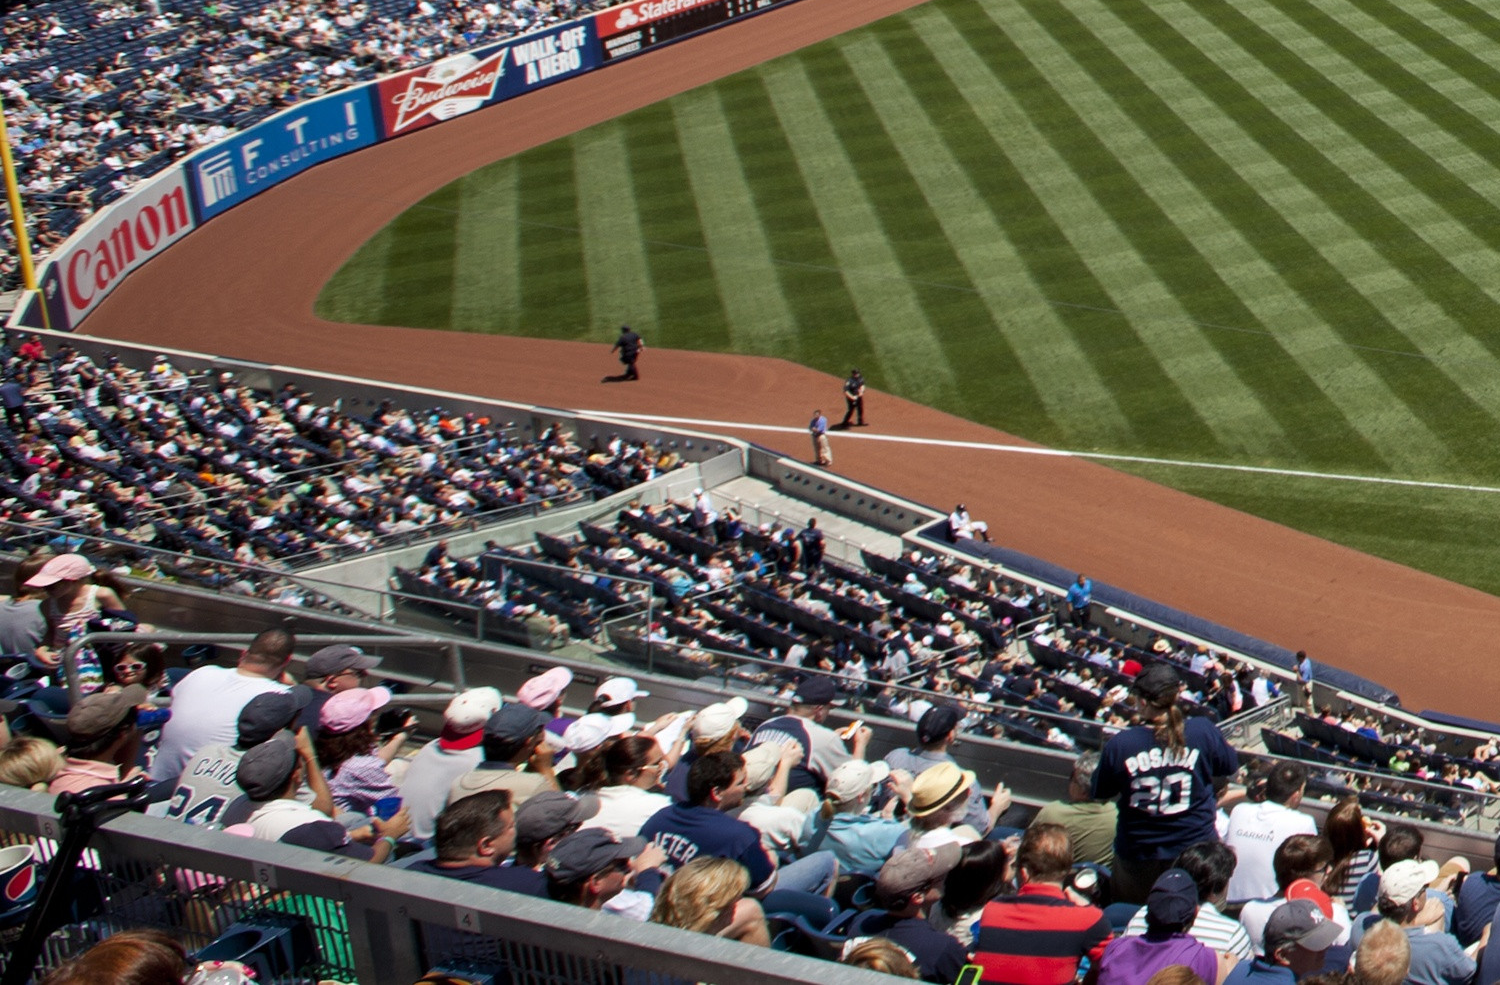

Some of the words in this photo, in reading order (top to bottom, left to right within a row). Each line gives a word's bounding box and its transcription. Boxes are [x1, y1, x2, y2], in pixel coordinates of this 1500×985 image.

[526, 63, 539, 85] A
[538, 48, 581, 80] HERO
[392, 65, 506, 113] Budweiser
[244, 127, 360, 185] CONSULTING
[66, 184, 190, 310] Canon
[1129, 771, 1193, 815] 20
[44, 820, 54, 836] 6
[1236, 828, 1275, 842] GARMIN
[260, 867, 270, 882] 5
[462, 914, 472, 927] 4
